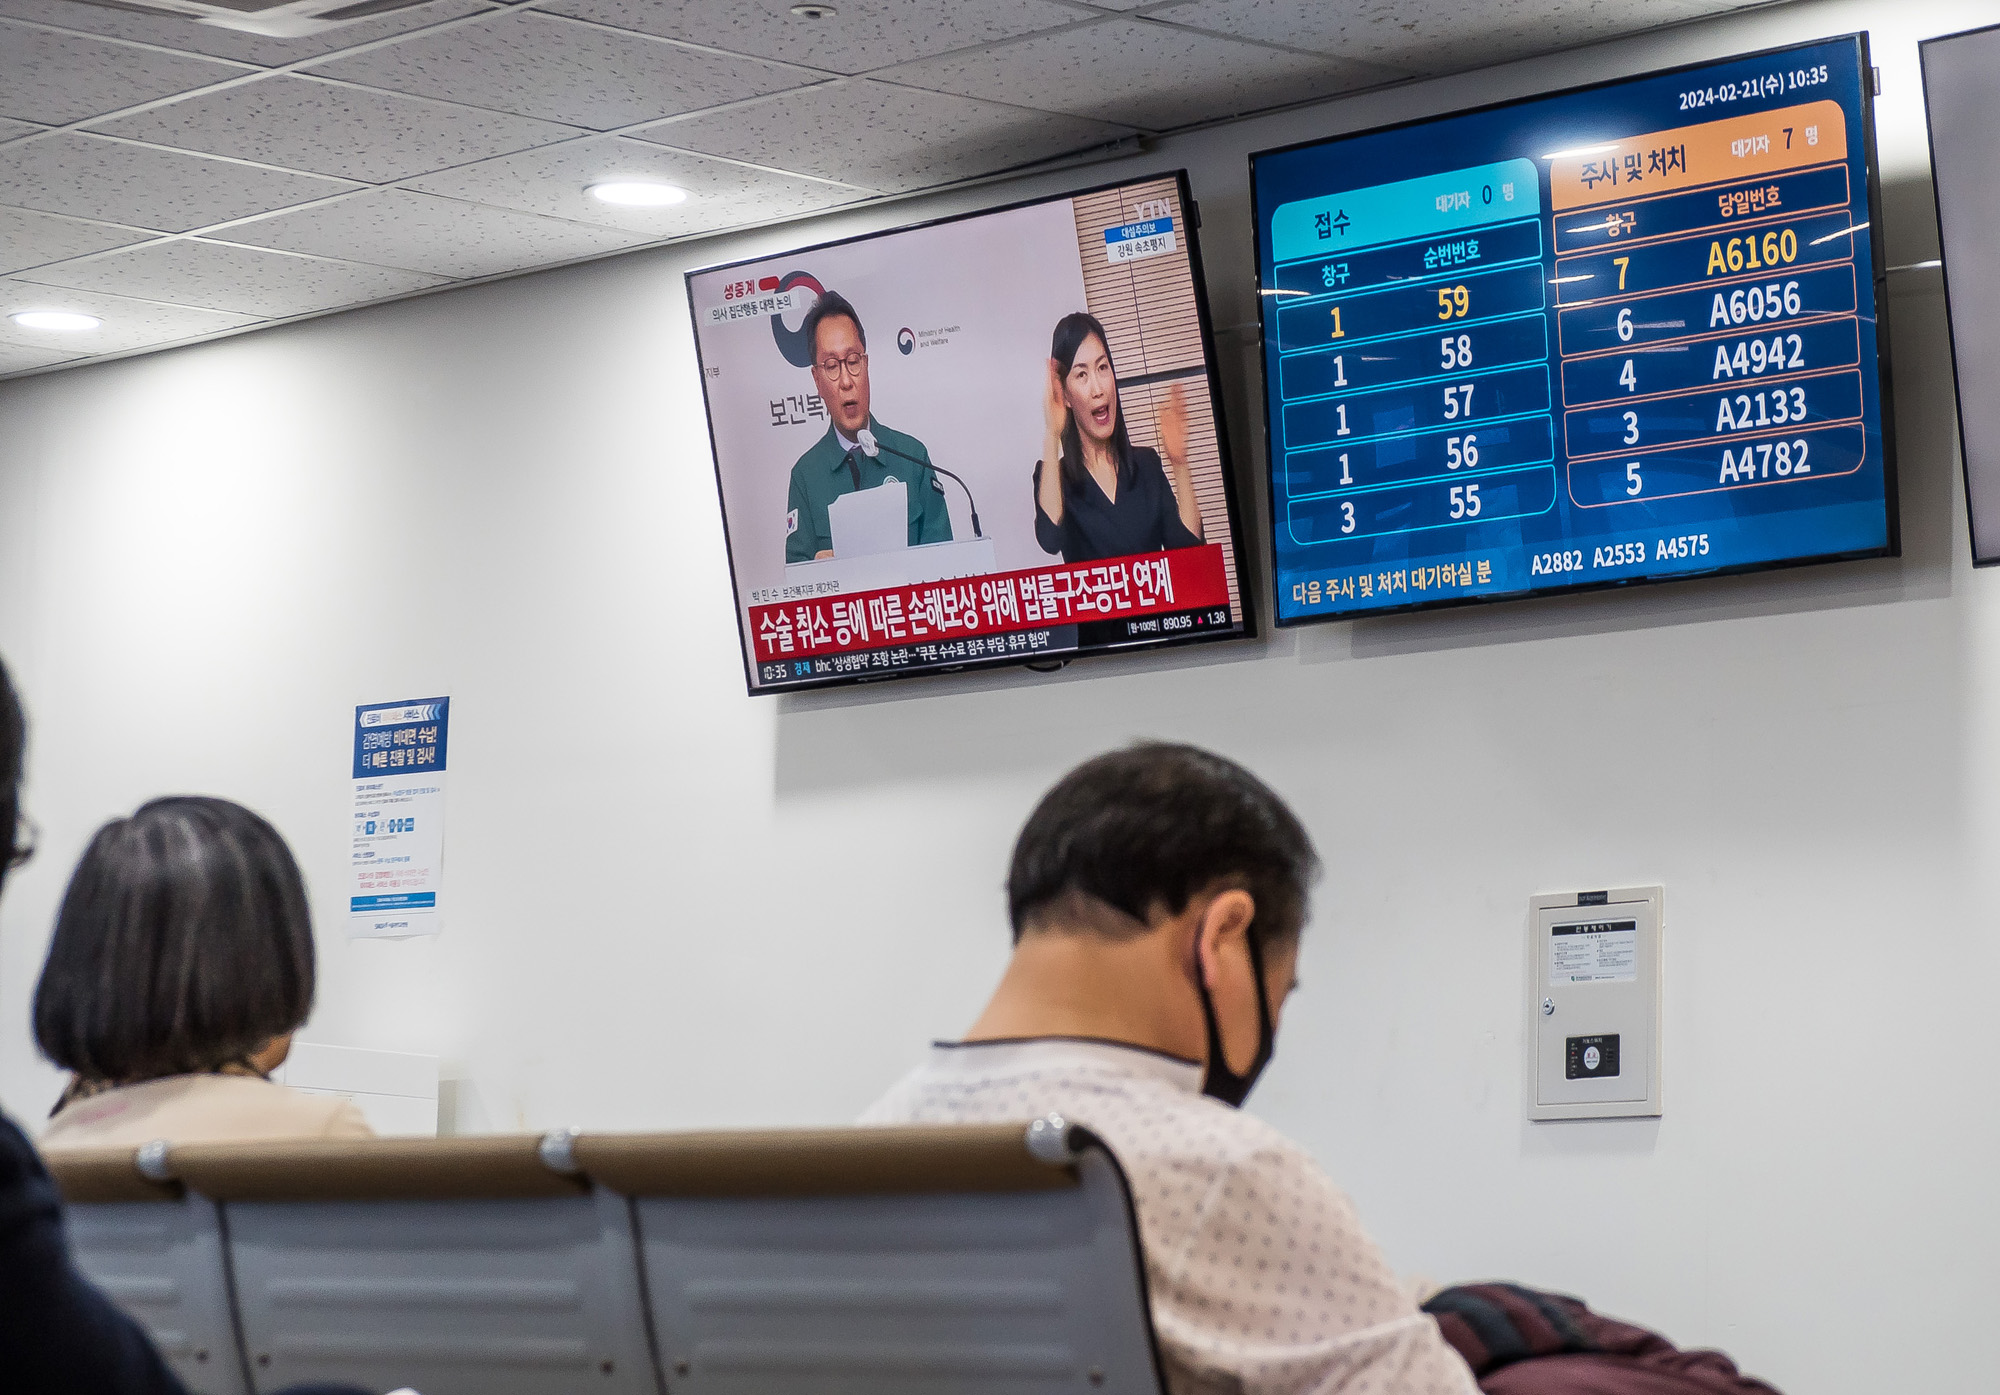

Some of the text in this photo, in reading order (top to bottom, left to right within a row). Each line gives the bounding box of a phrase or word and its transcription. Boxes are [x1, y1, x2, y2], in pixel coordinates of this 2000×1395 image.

[1679, 65, 1829, 111] 2024-02-21(수) 10:35
[1731, 125, 1819, 158] 대기자 7 명
[1580, 144, 1687, 190] 주사 및 처치
[1133, 197, 1172, 220] YTN
[1435, 182, 1514, 213] 대기자 0 명
[1605, 185, 1783, 238] 창구 당일번호
[1117, 236, 1166, 258] 강원 속초평지
[1121, 222, 1157, 238] 대설주의보
[1314, 209, 1351, 240] 접수
[1321, 239, 1481, 288] 창구 순번번호
[1613, 228, 1798, 290] 7 A6160
[712, 294, 792, 321] 의사 집단행동 대책 논의
[723, 279, 756, 300] 생중계
[1330, 285, 1469, 338] 1 59
[1617, 281, 1801, 341] 6 A6056
[1333, 334, 1473, 387] 1 58
[1619, 334, 1804, 392] 4 A4942
[769, 393, 829, 427] 보건복
[1336, 384, 1474, 435] 1 57
[1622, 387, 1807, 445] 3 A2133
[1339, 434, 1479, 485] 1 56
[1626, 439, 1811, 496] 5 A4782
[1340, 484, 1481, 534] 3 55
[1531, 534, 1710, 576] A2882 A2553 A4575
[782, 584, 814, 598] 보건복지부
[1293, 559, 1492, 605] 다음 주사 및 처치 대기하실 분
[760, 557, 1175, 654] 수술 취소 등에 따른 손해보상 위해 법률구조공단 연계
[1163, 615, 1192, 630] 890.95
[1207, 611, 1226, 625] 1.38
[794, 661, 811, 676] 경제
[815, 660, 832, 673] bhc
[872, 650, 889, 667] 조항
[939, 642, 966, 659] 수수료
[967, 638, 986, 656] 점주
[372, 750, 388, 769] 빠른
[407, 748, 415, 765] 및
[394, 728, 417, 746] 비대면
